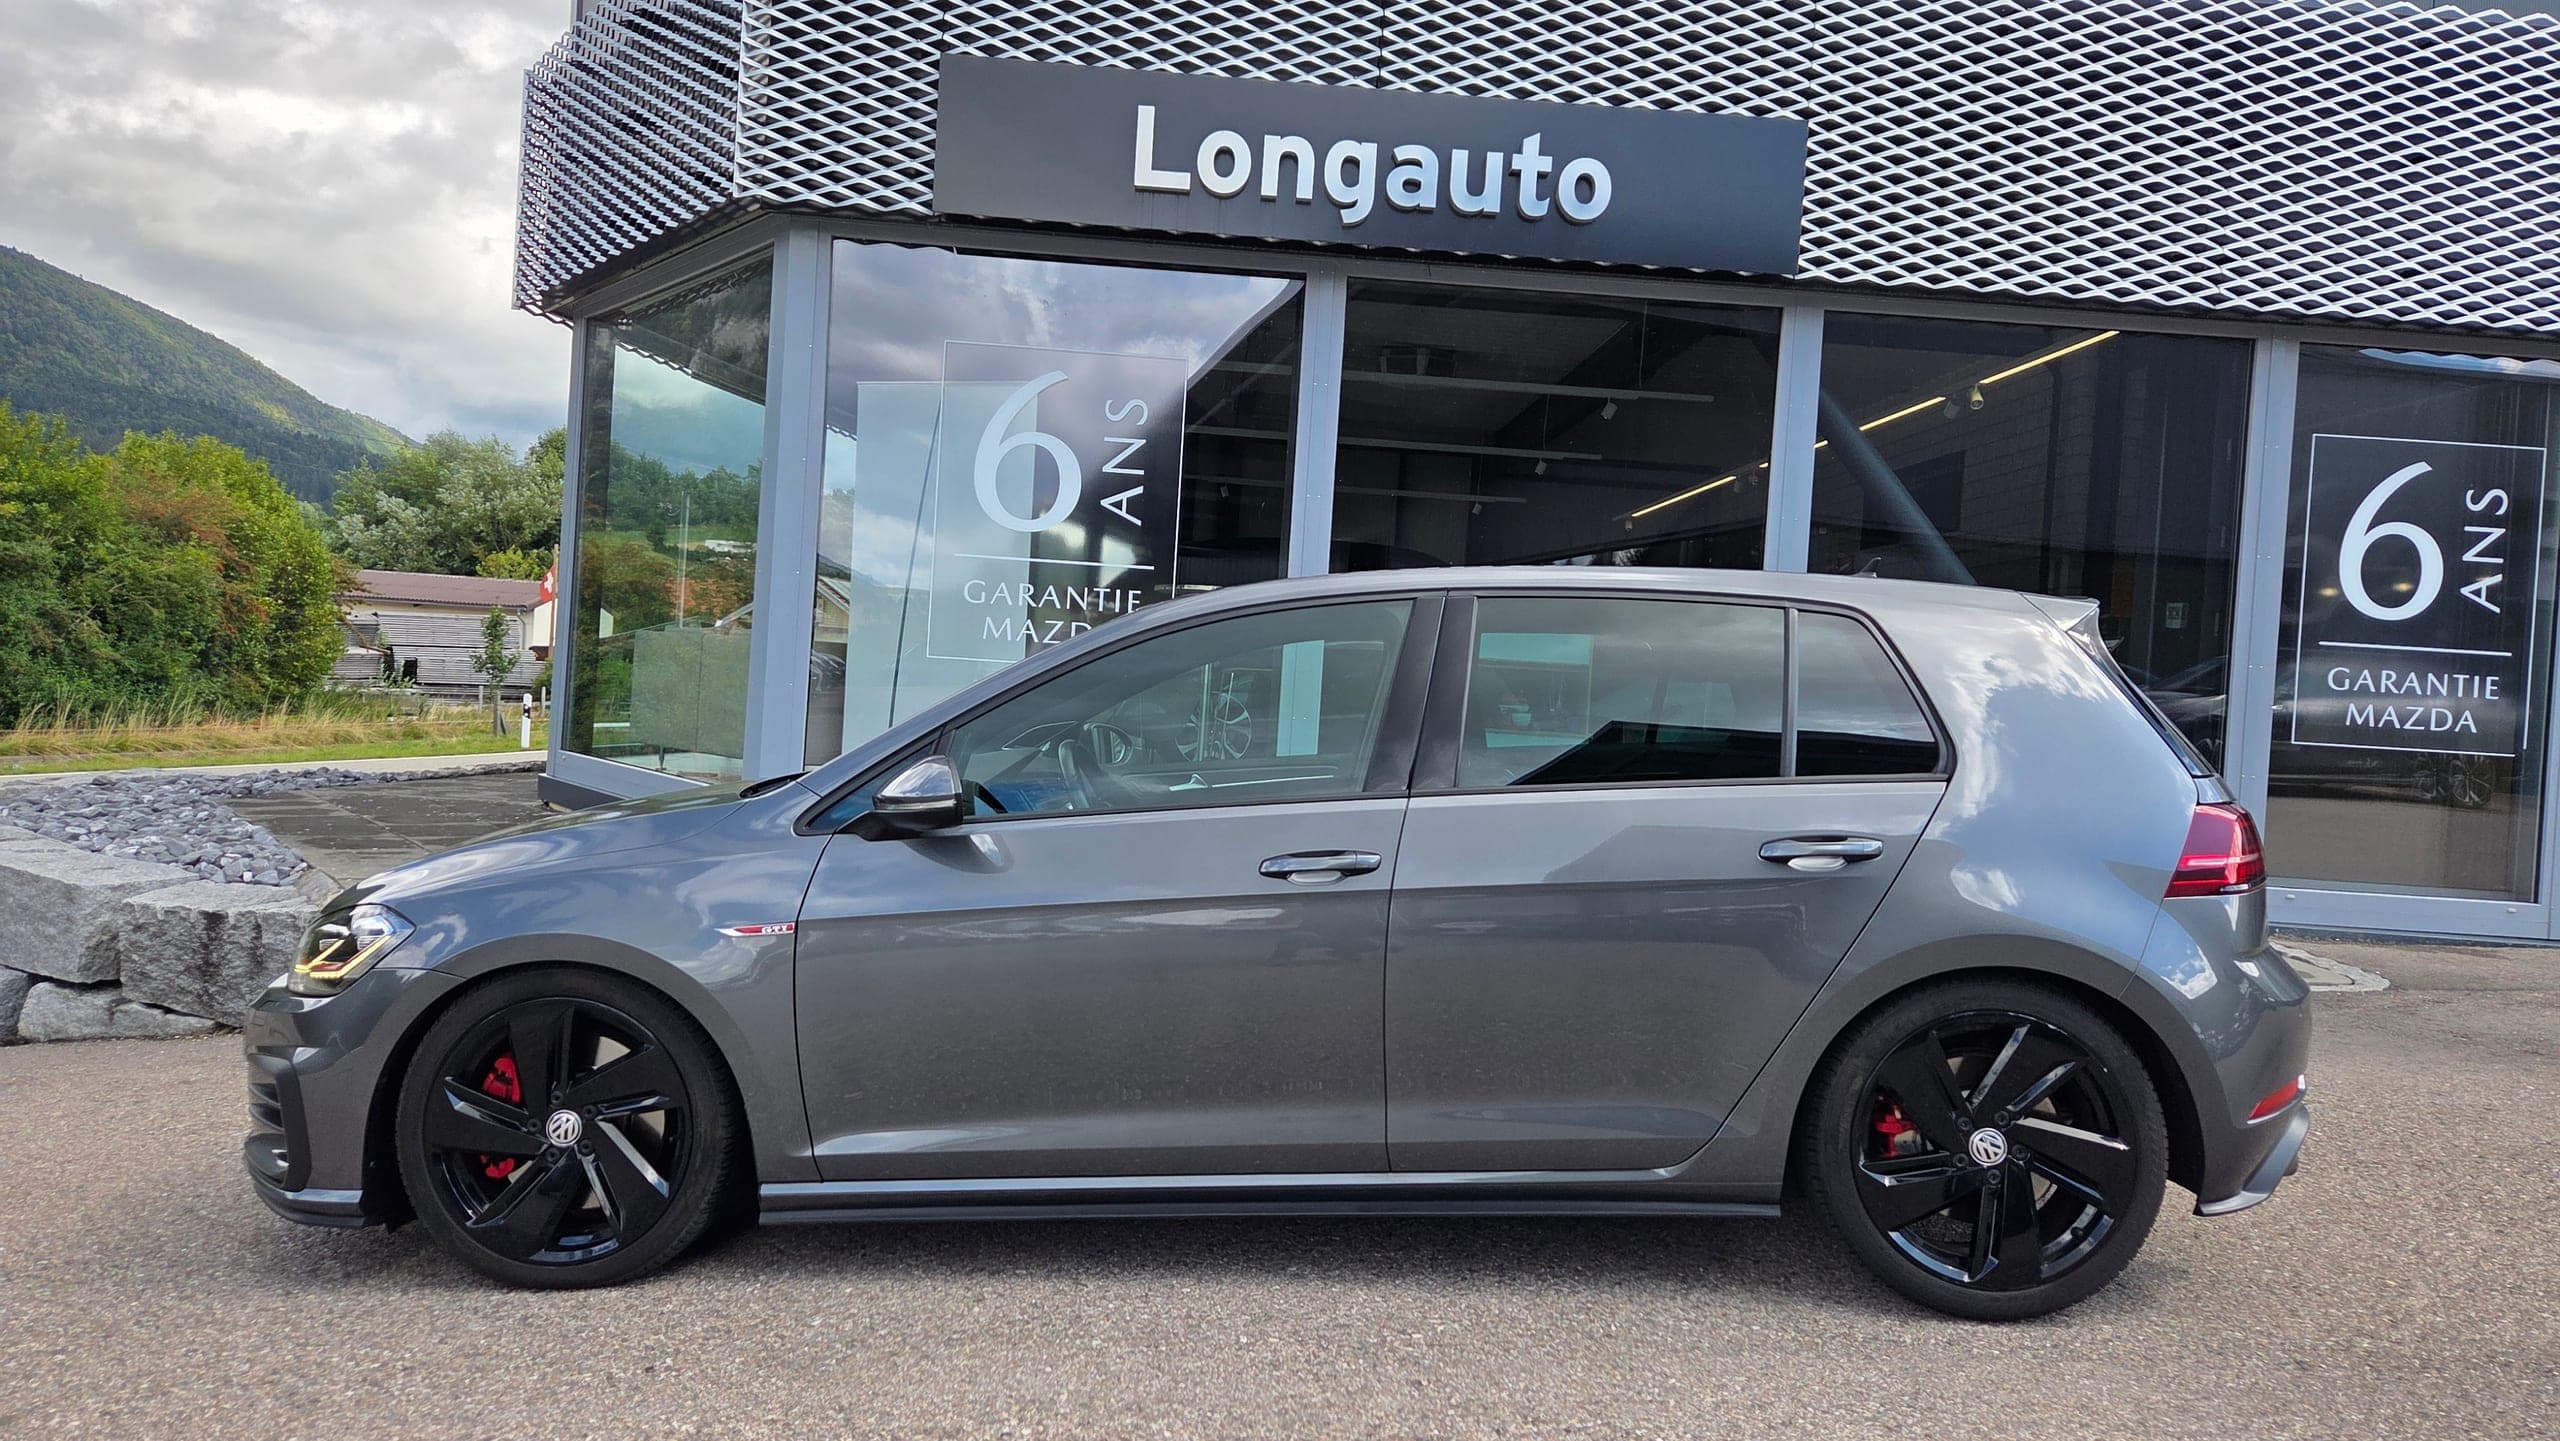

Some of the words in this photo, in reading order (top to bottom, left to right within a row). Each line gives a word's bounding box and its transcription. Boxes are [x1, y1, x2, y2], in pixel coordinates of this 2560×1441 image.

[1132, 103, 1614, 228] Longauto
[973, 369, 1082, 533] 6
[1100, 398, 1149, 527] ANS
[2338, 461, 2444, 621] 6
[2460, 488, 2509, 614] ANS
[963, 579, 1143, 614] GARANTIE
[982, 616, 1093, 644] MAZD
[2327, 666, 2500, 701] GARANTIE
[2345, 703, 2478, 734] MAZDA
[761, 923, 788, 935] GTI
